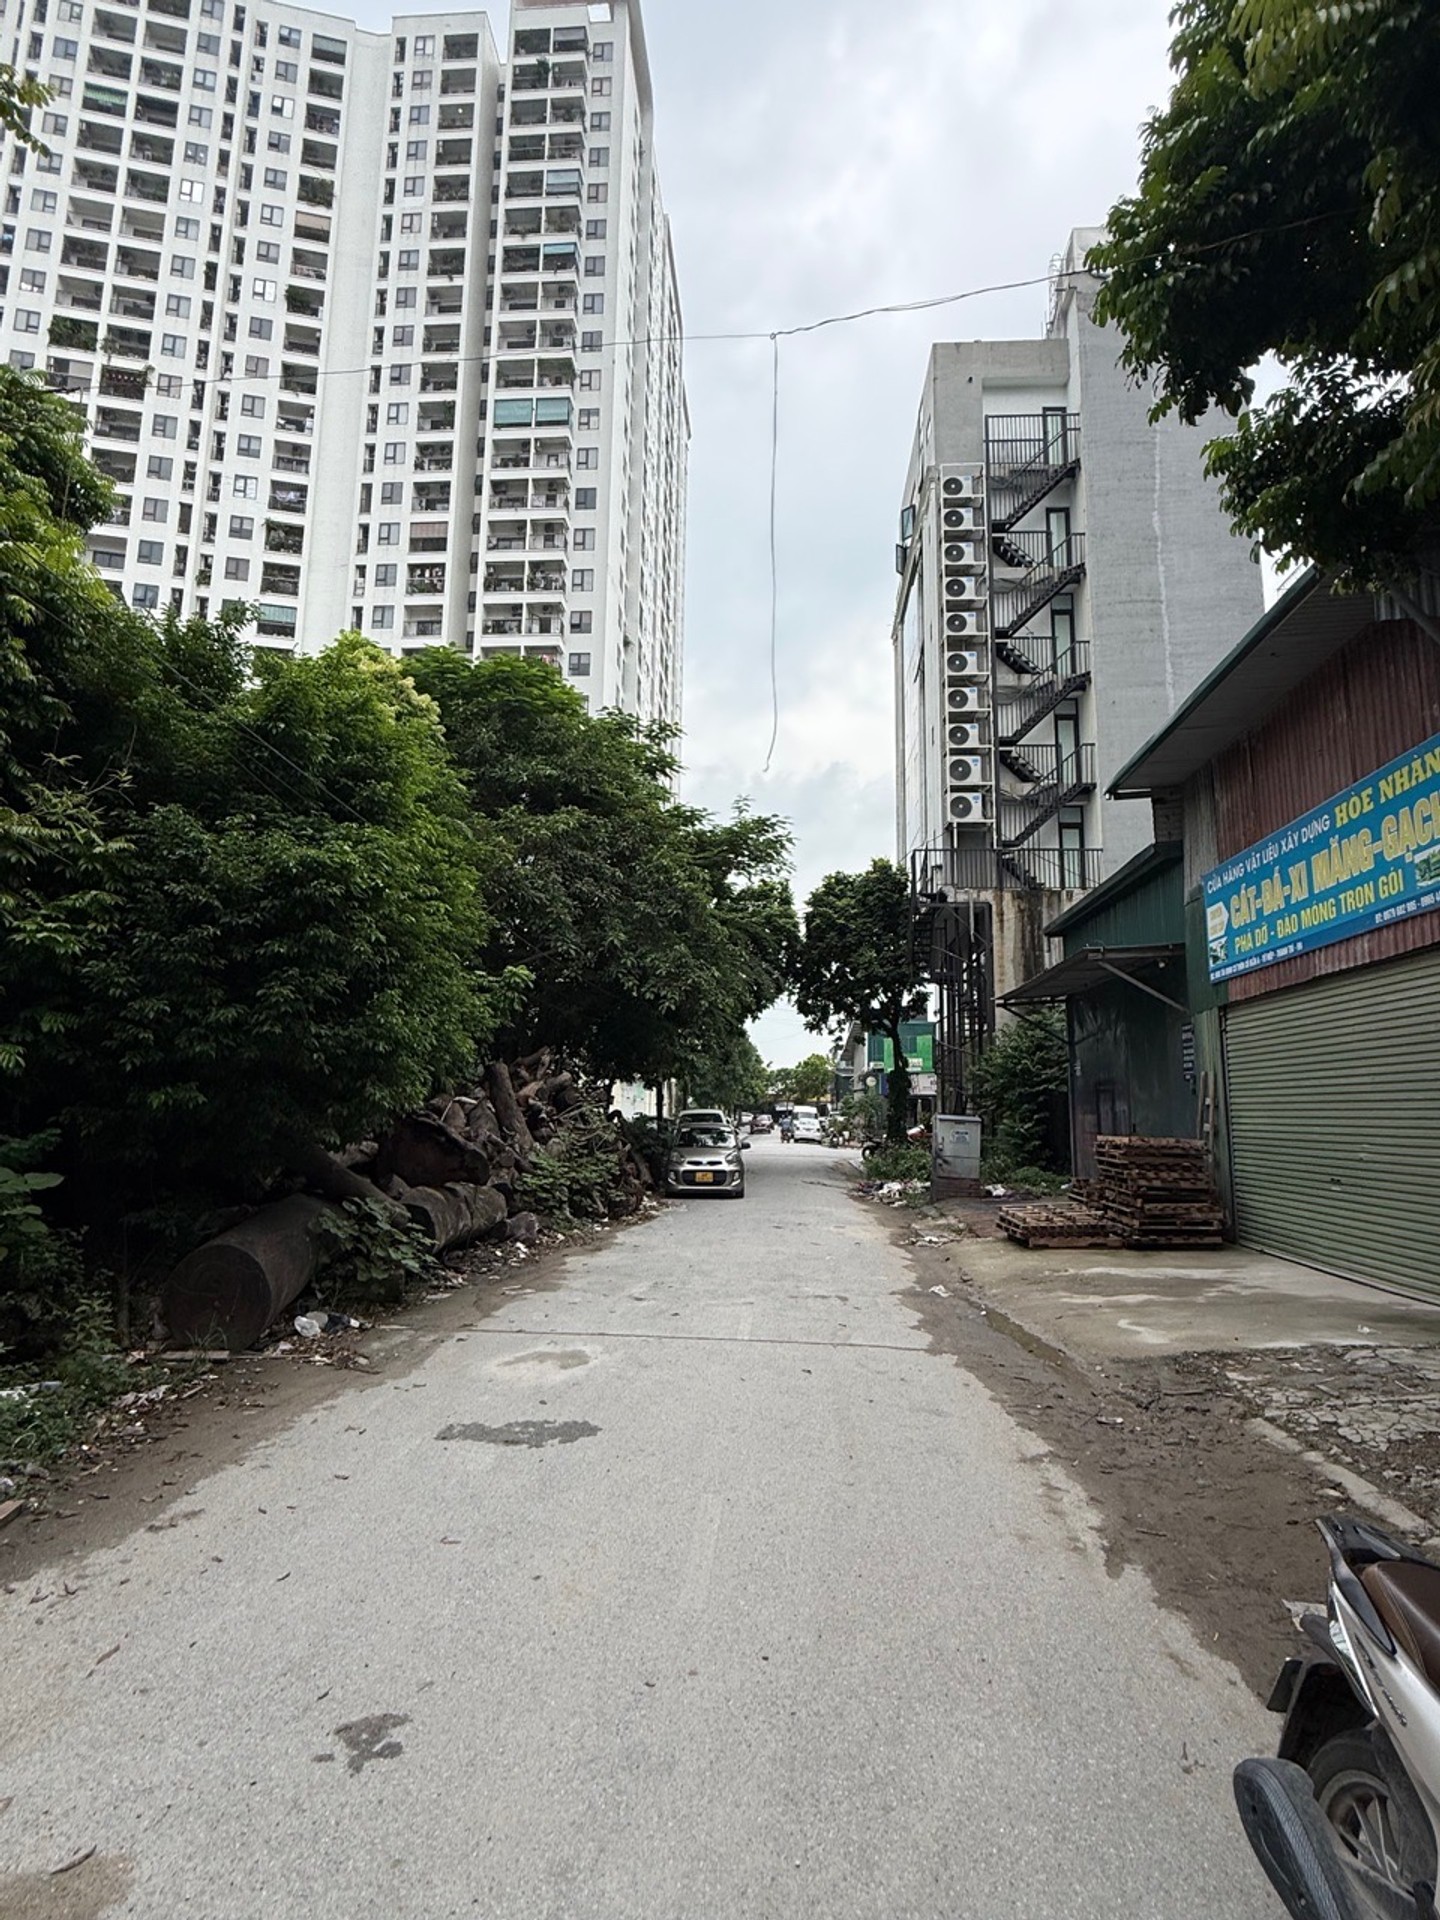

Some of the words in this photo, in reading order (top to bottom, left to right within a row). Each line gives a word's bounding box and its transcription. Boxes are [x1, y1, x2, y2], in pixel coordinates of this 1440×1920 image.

[1280, 831, 1299, 855] XÂY
[1334, 787, 1374, 828] HÒE
[1300, 898, 1337, 930] MÓNG
[1338, 881, 1376, 915] TRỌN
[1378, 867, 1404, 900] GÓI
